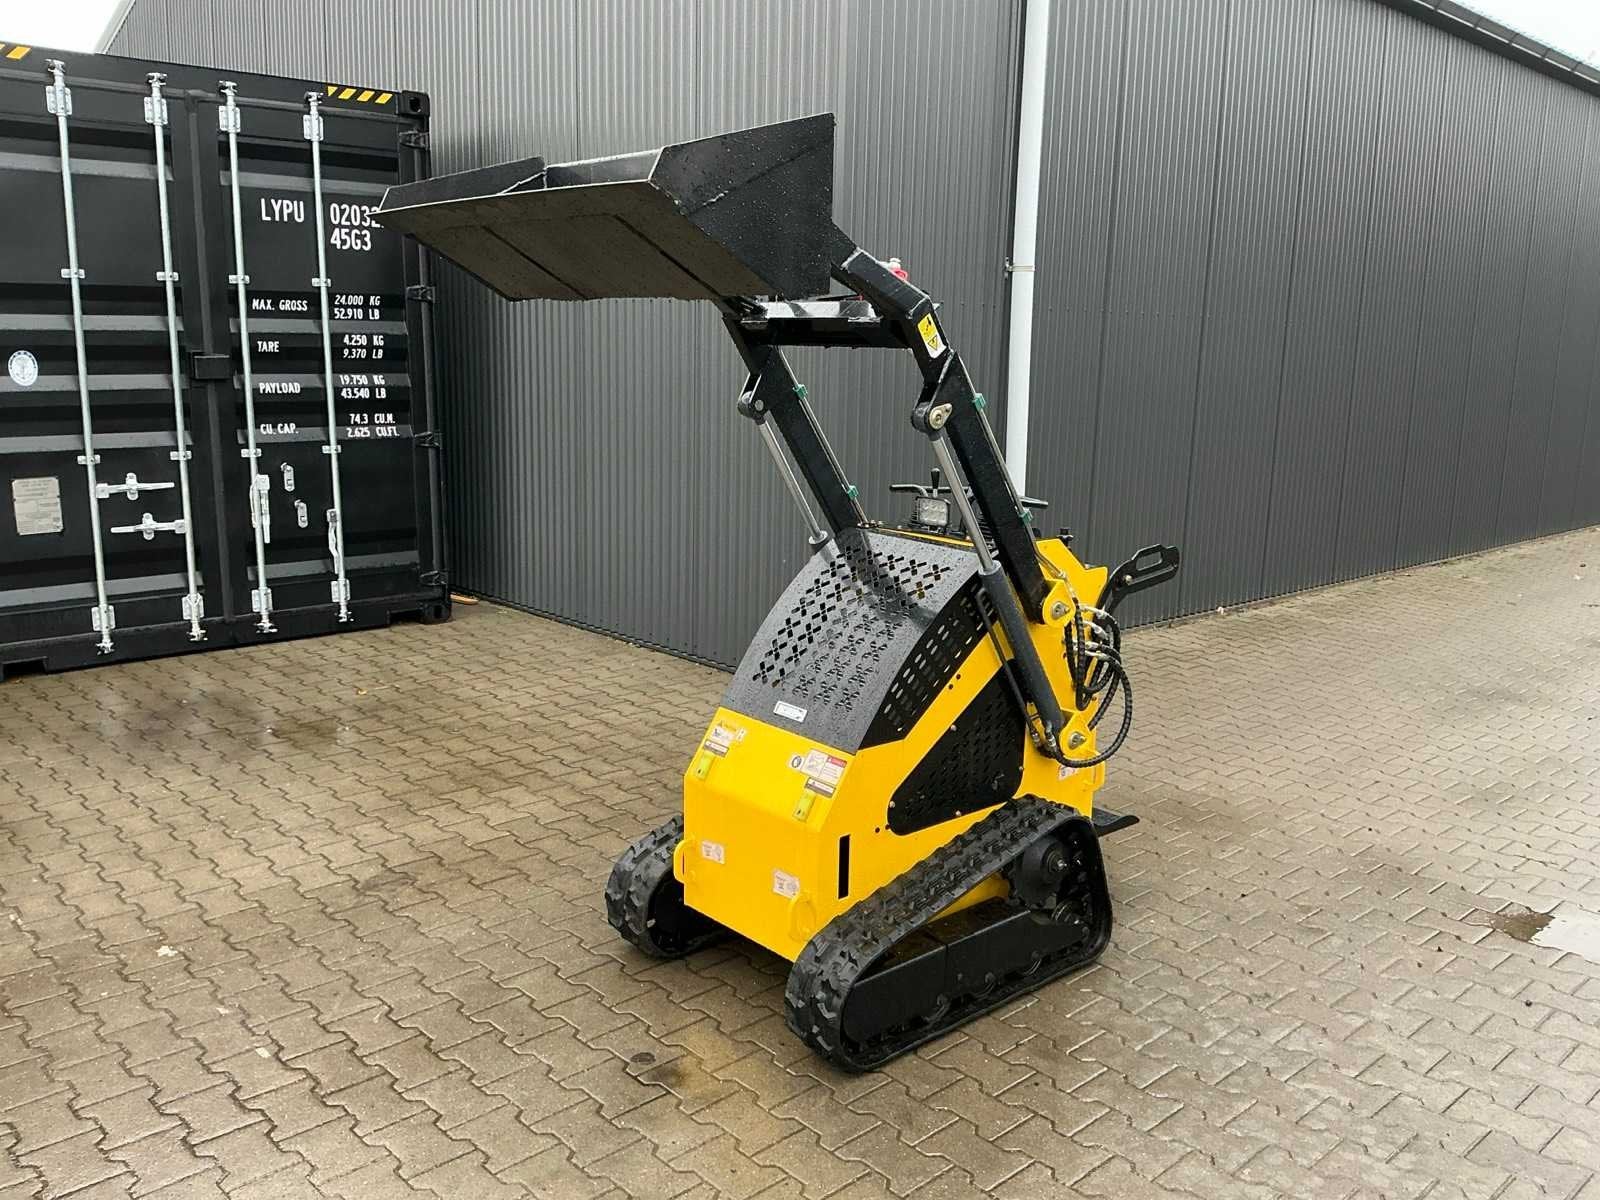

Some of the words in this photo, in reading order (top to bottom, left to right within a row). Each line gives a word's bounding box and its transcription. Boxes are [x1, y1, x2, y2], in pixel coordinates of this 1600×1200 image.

[261, 198, 304, 222] LYPU
[330, 203, 384, 228] 02032
[330, 227, 372, 251] 45G3
[252, 298, 275, 311] MAX.
[279, 299, 308, 311] GROSS
[334, 294, 364, 306] 24.000
[369, 295, 381, 306] KG
[334, 308, 363, 320] 52.910
[369, 308, 380, 320] LB
[343, 334, 367, 346] 4.250
[373, 335, 384, 346] KG
[257, 341, 280, 353] TARE
[343, 348, 367, 359] 9.370
[372, 348, 384, 359] LB
[339, 374, 368, 385] 19.750
[374, 374, 386, 386] KG
[259, 382, 301, 394] PAYLOAD
[341, 388, 370, 399] 43.540
[375, 388, 387, 399] LB
[349, 413, 369, 425] 74.3
[346, 427, 371, 438] 2.625
